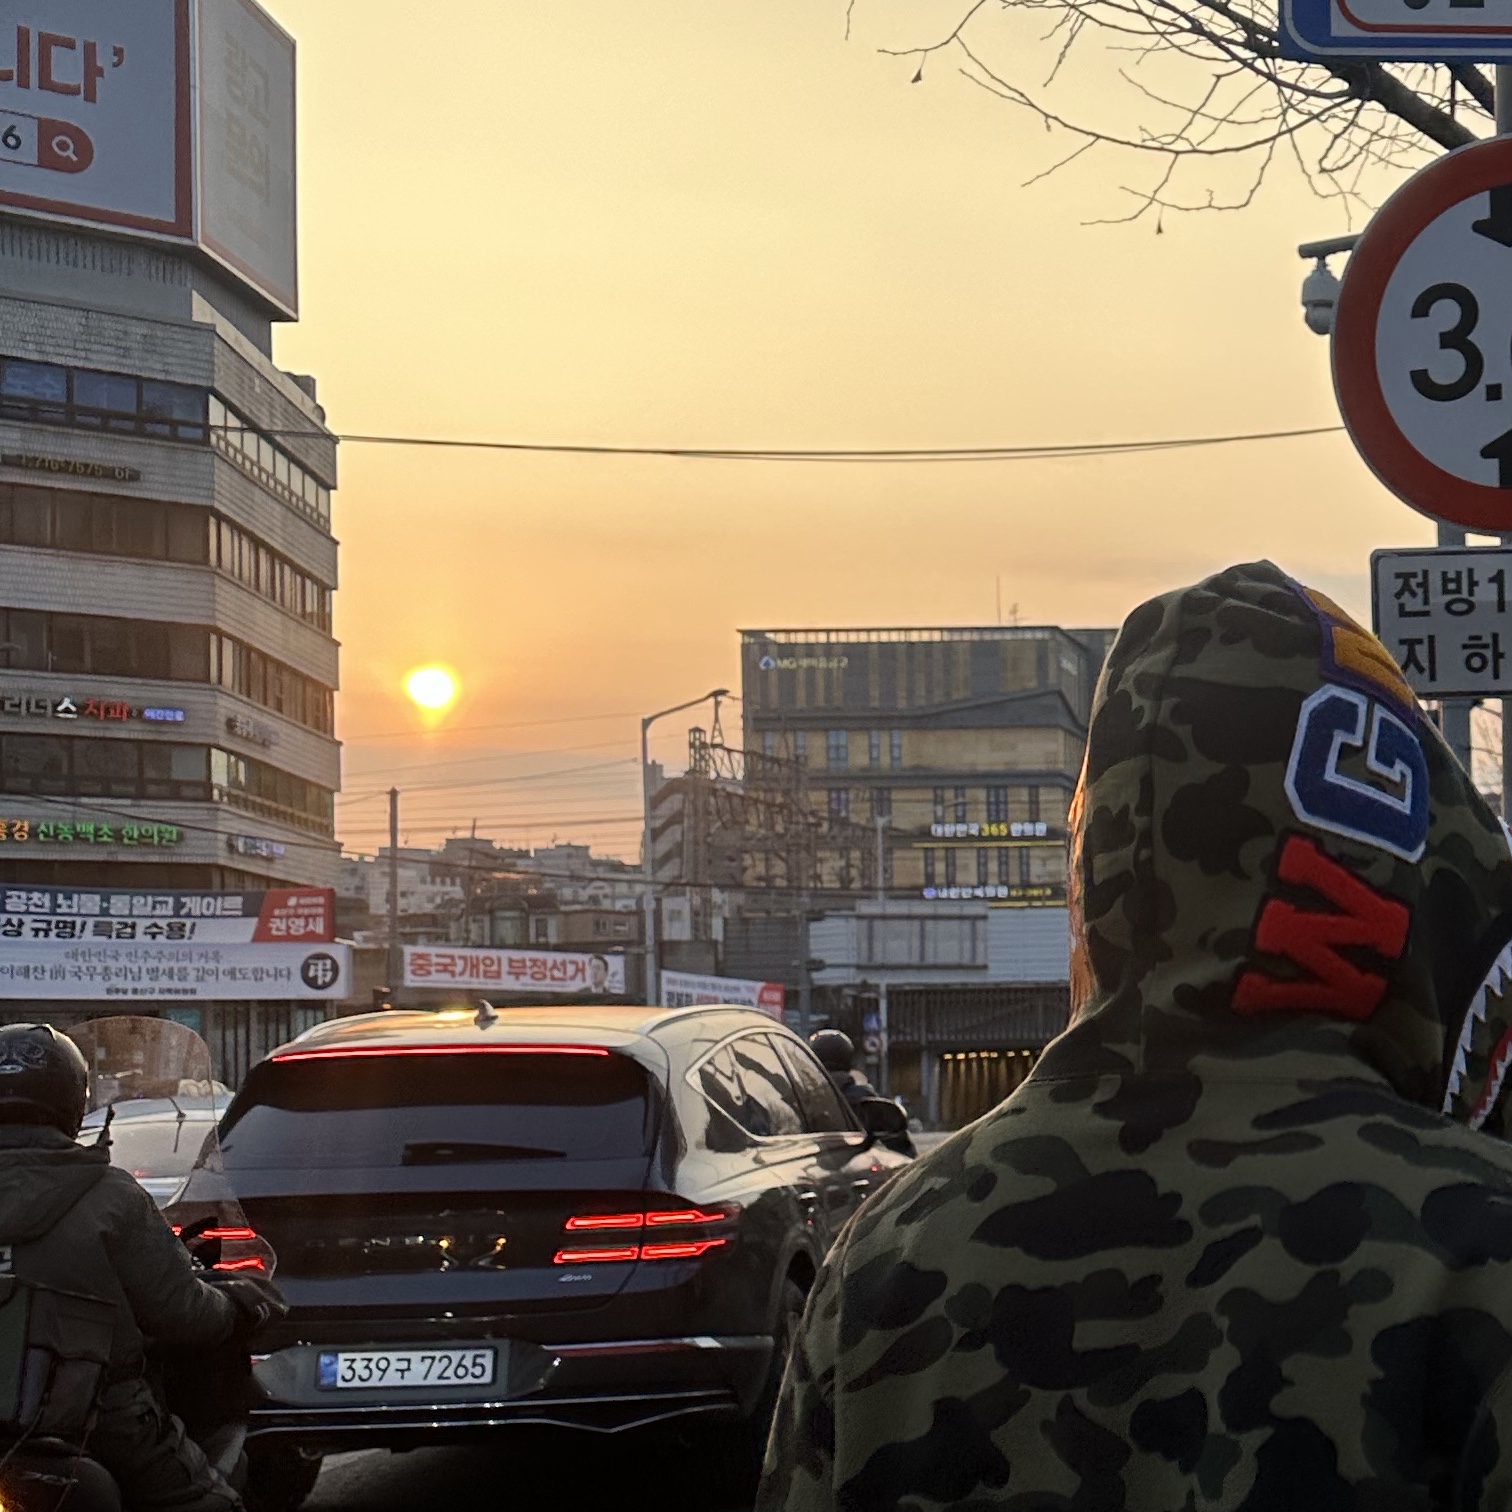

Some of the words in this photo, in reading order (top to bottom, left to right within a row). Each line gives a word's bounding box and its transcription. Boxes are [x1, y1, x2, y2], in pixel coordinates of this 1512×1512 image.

[121, 823, 180, 847] 한의원
[5, 890, 50, 913] 공천
[179, 896, 244, 917] 게이트
[30, 918, 87, 940] 규명!
[143, 920, 197, 941] 수용!
[268, 916, 325, 936] 권영세
[0, 963, 46, 982] 이해찬
[409, 952, 503, 980] 중국개입
[507, 956, 587, 982] 부정선거
